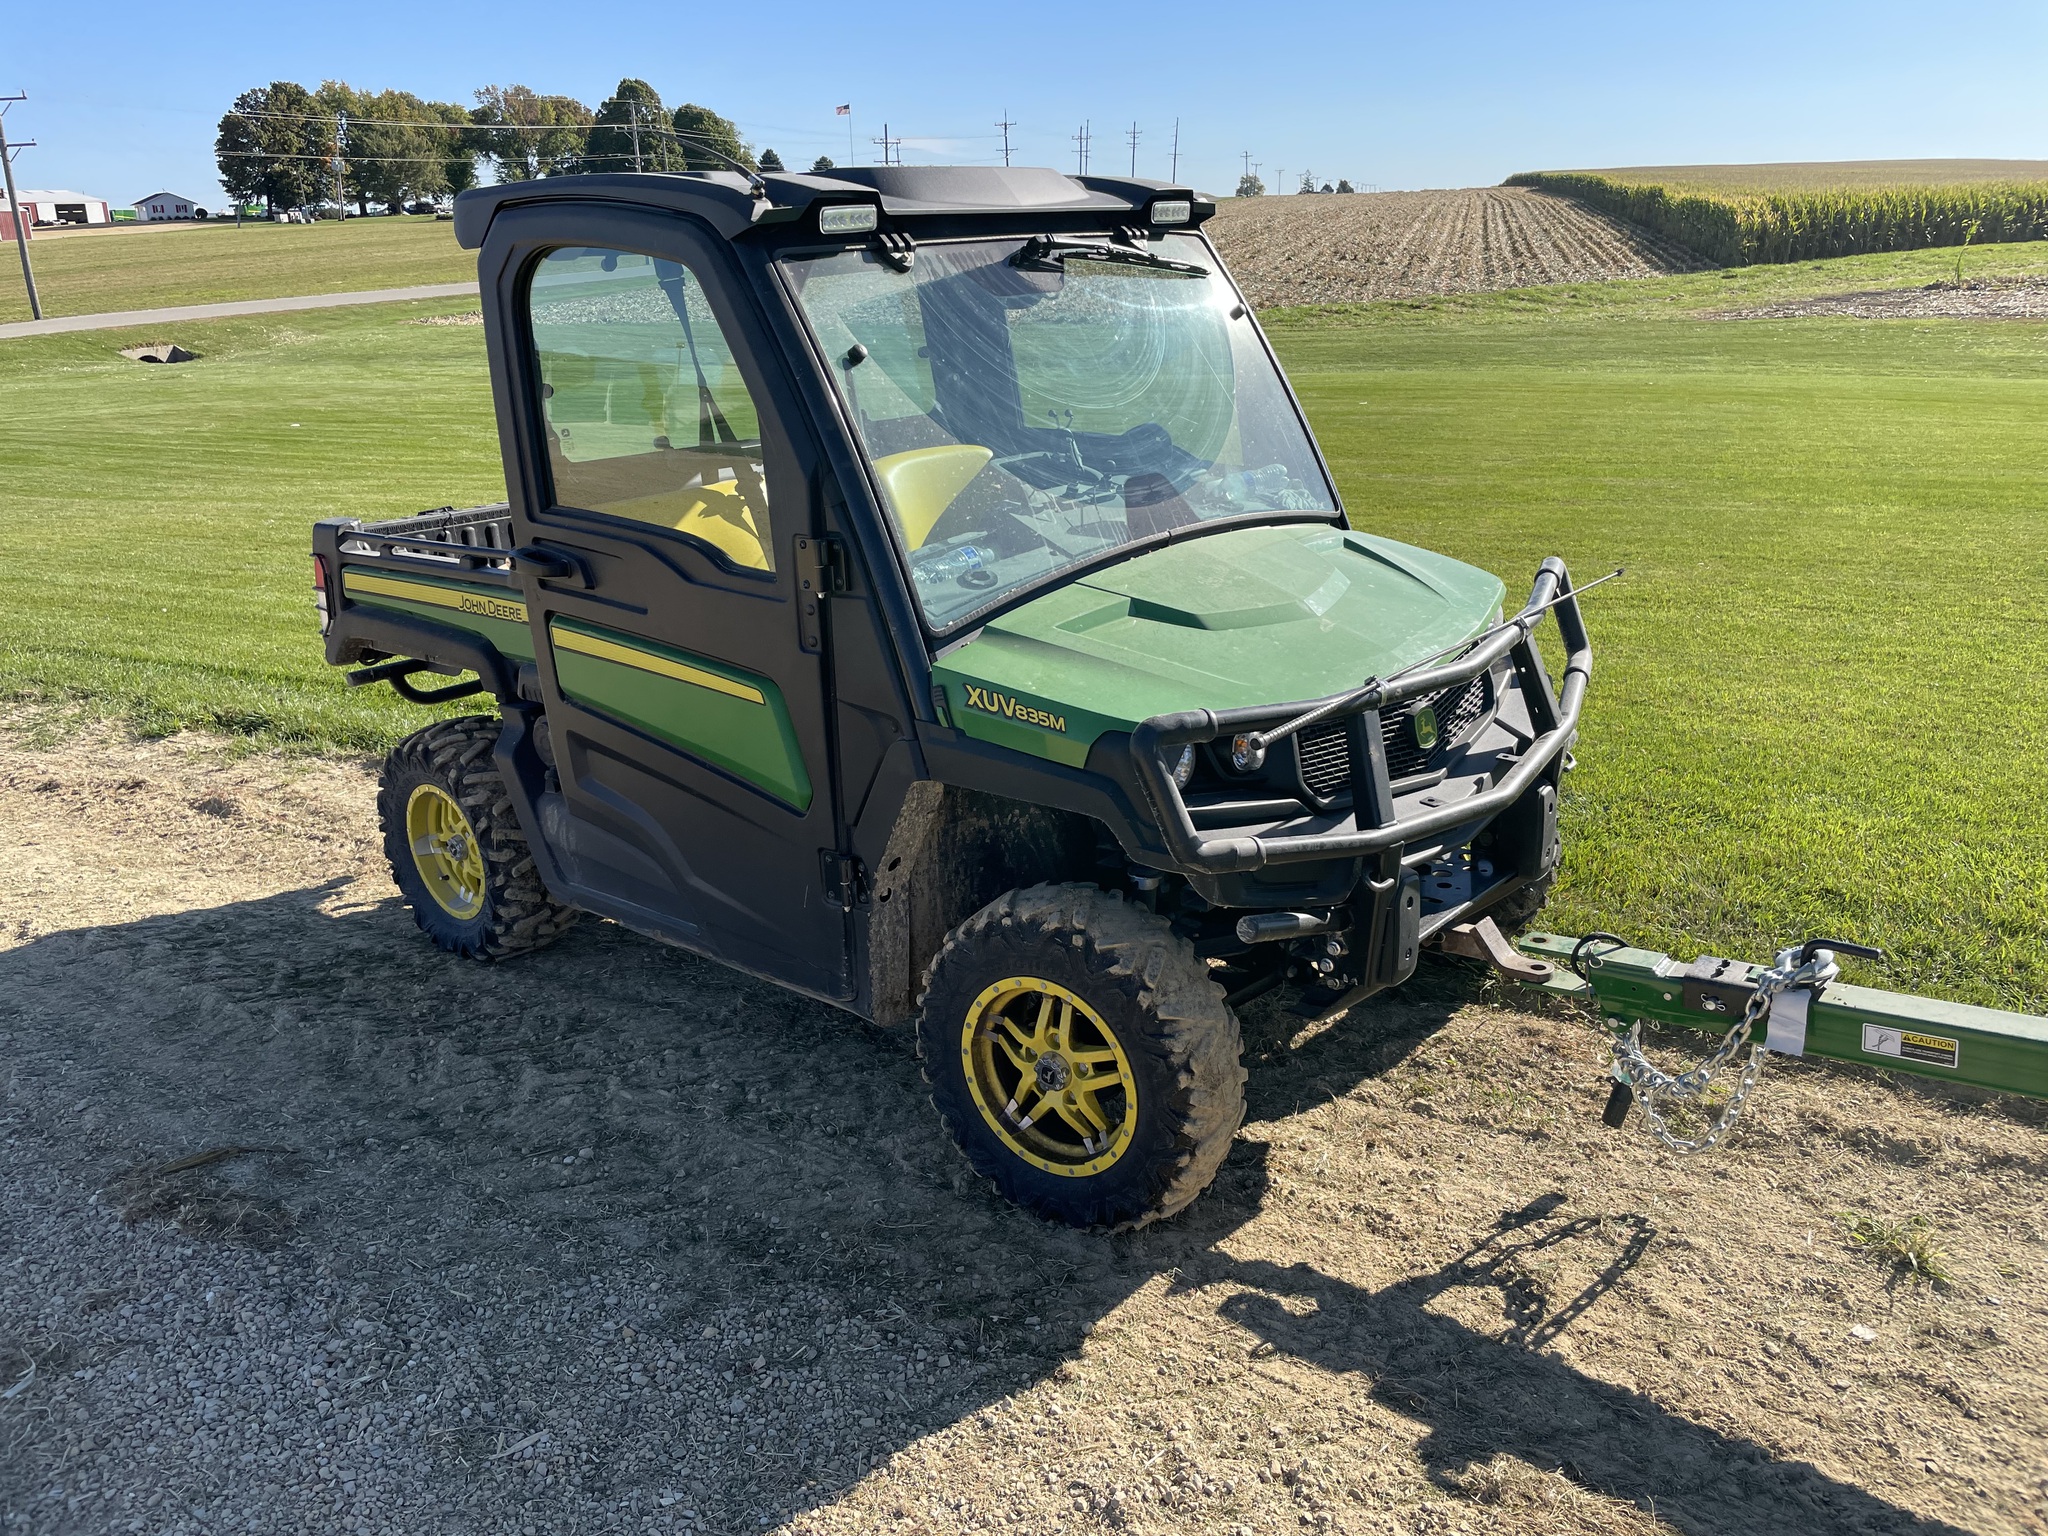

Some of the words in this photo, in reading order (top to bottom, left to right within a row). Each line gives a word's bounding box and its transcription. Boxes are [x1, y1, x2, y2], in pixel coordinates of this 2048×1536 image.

[459, 595, 486, 613] JOHN
[487, 600, 522, 620] DEERE
[964, 684, 1066, 732] XUV835M
[1911, 1036, 1954, 1049] CAUTION
